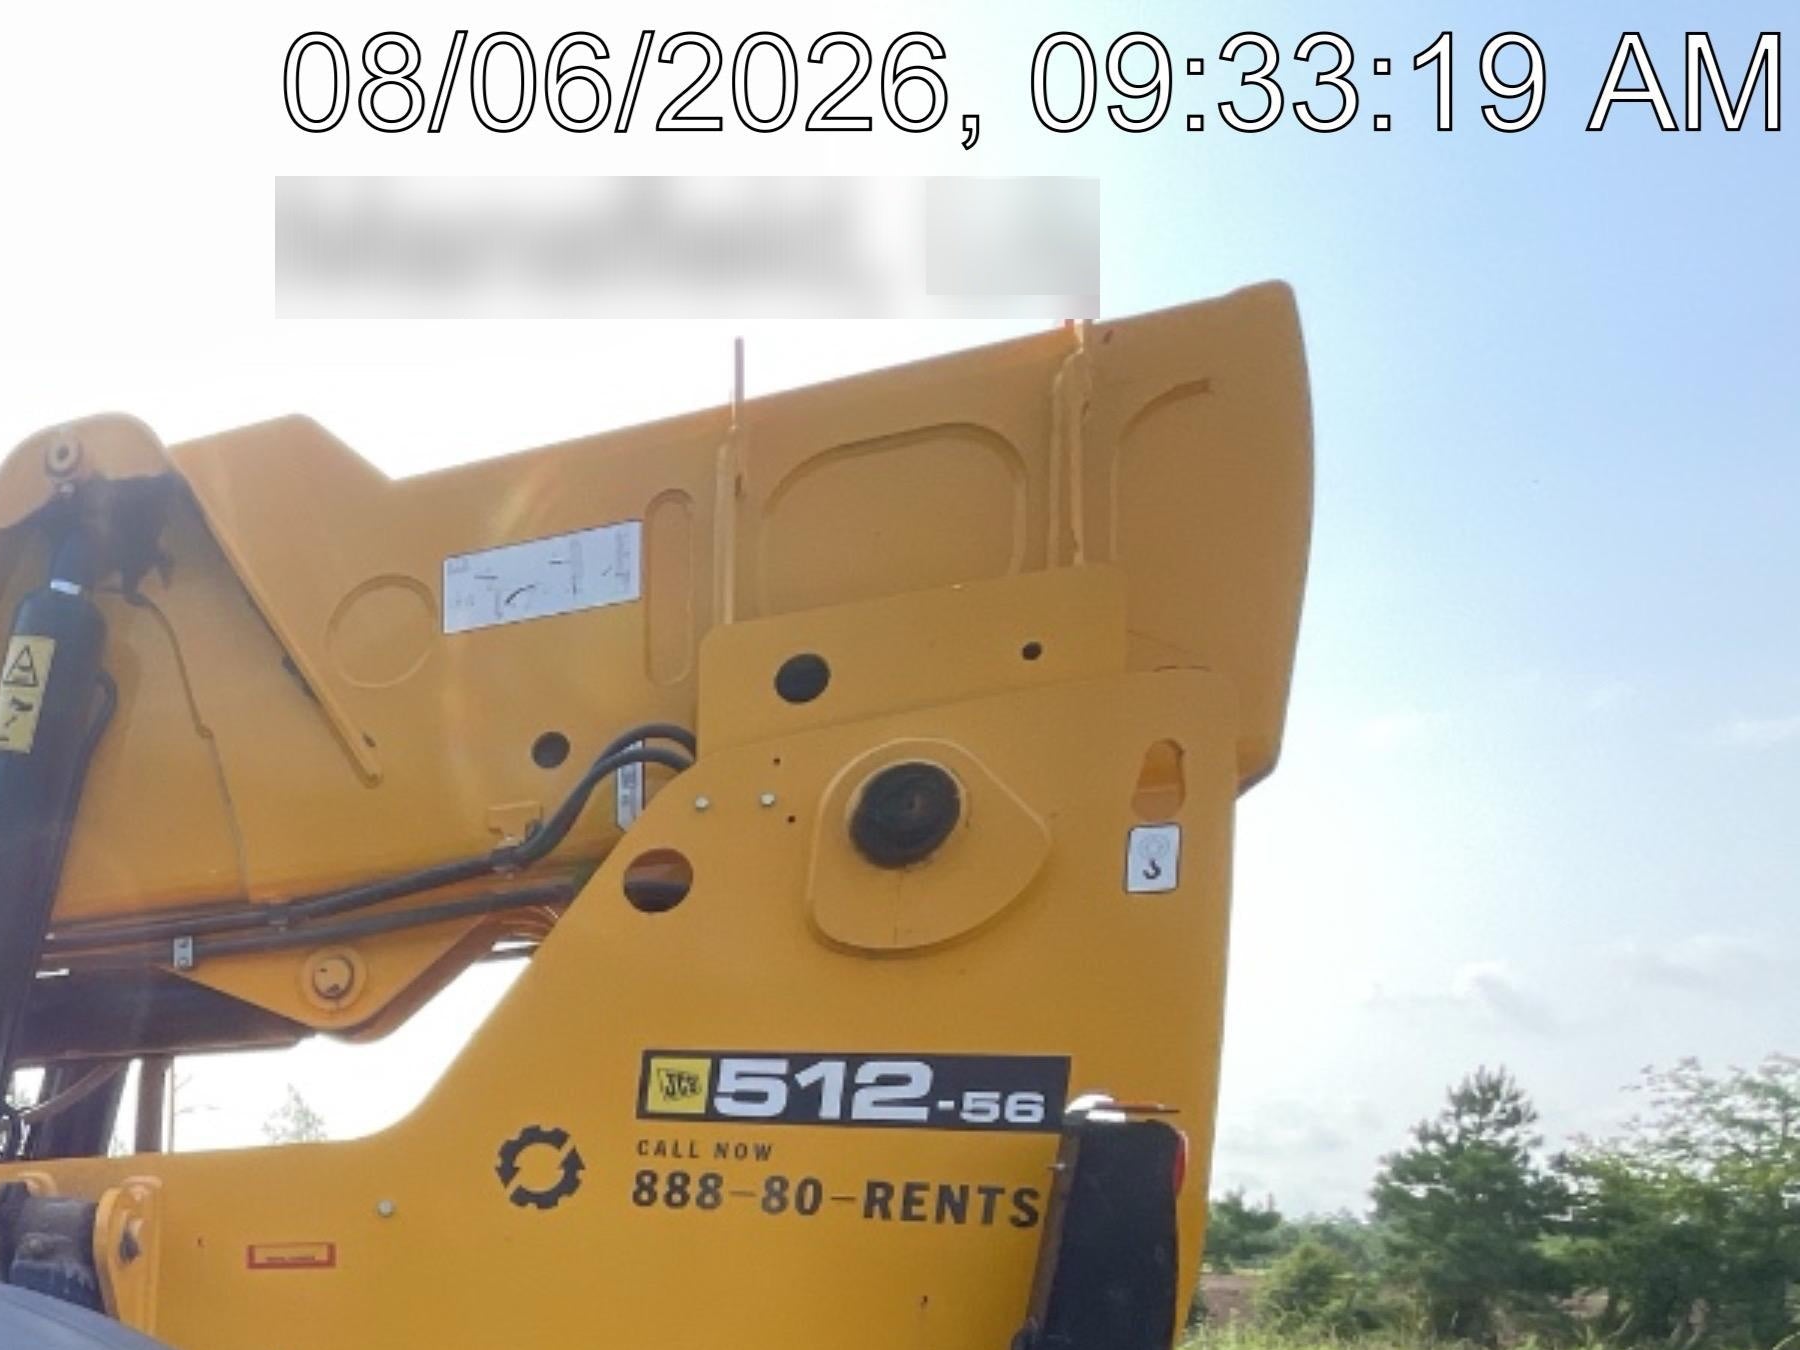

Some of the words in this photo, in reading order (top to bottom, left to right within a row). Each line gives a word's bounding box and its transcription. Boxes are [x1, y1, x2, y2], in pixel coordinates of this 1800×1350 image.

[713, 1057, 1046, 1123] 512-56
[636, 1138, 700, 1160] CALL
[713, 1141, 774, 1162] NOW
[632, 1169, 1042, 1229] 888-80-RENTS
